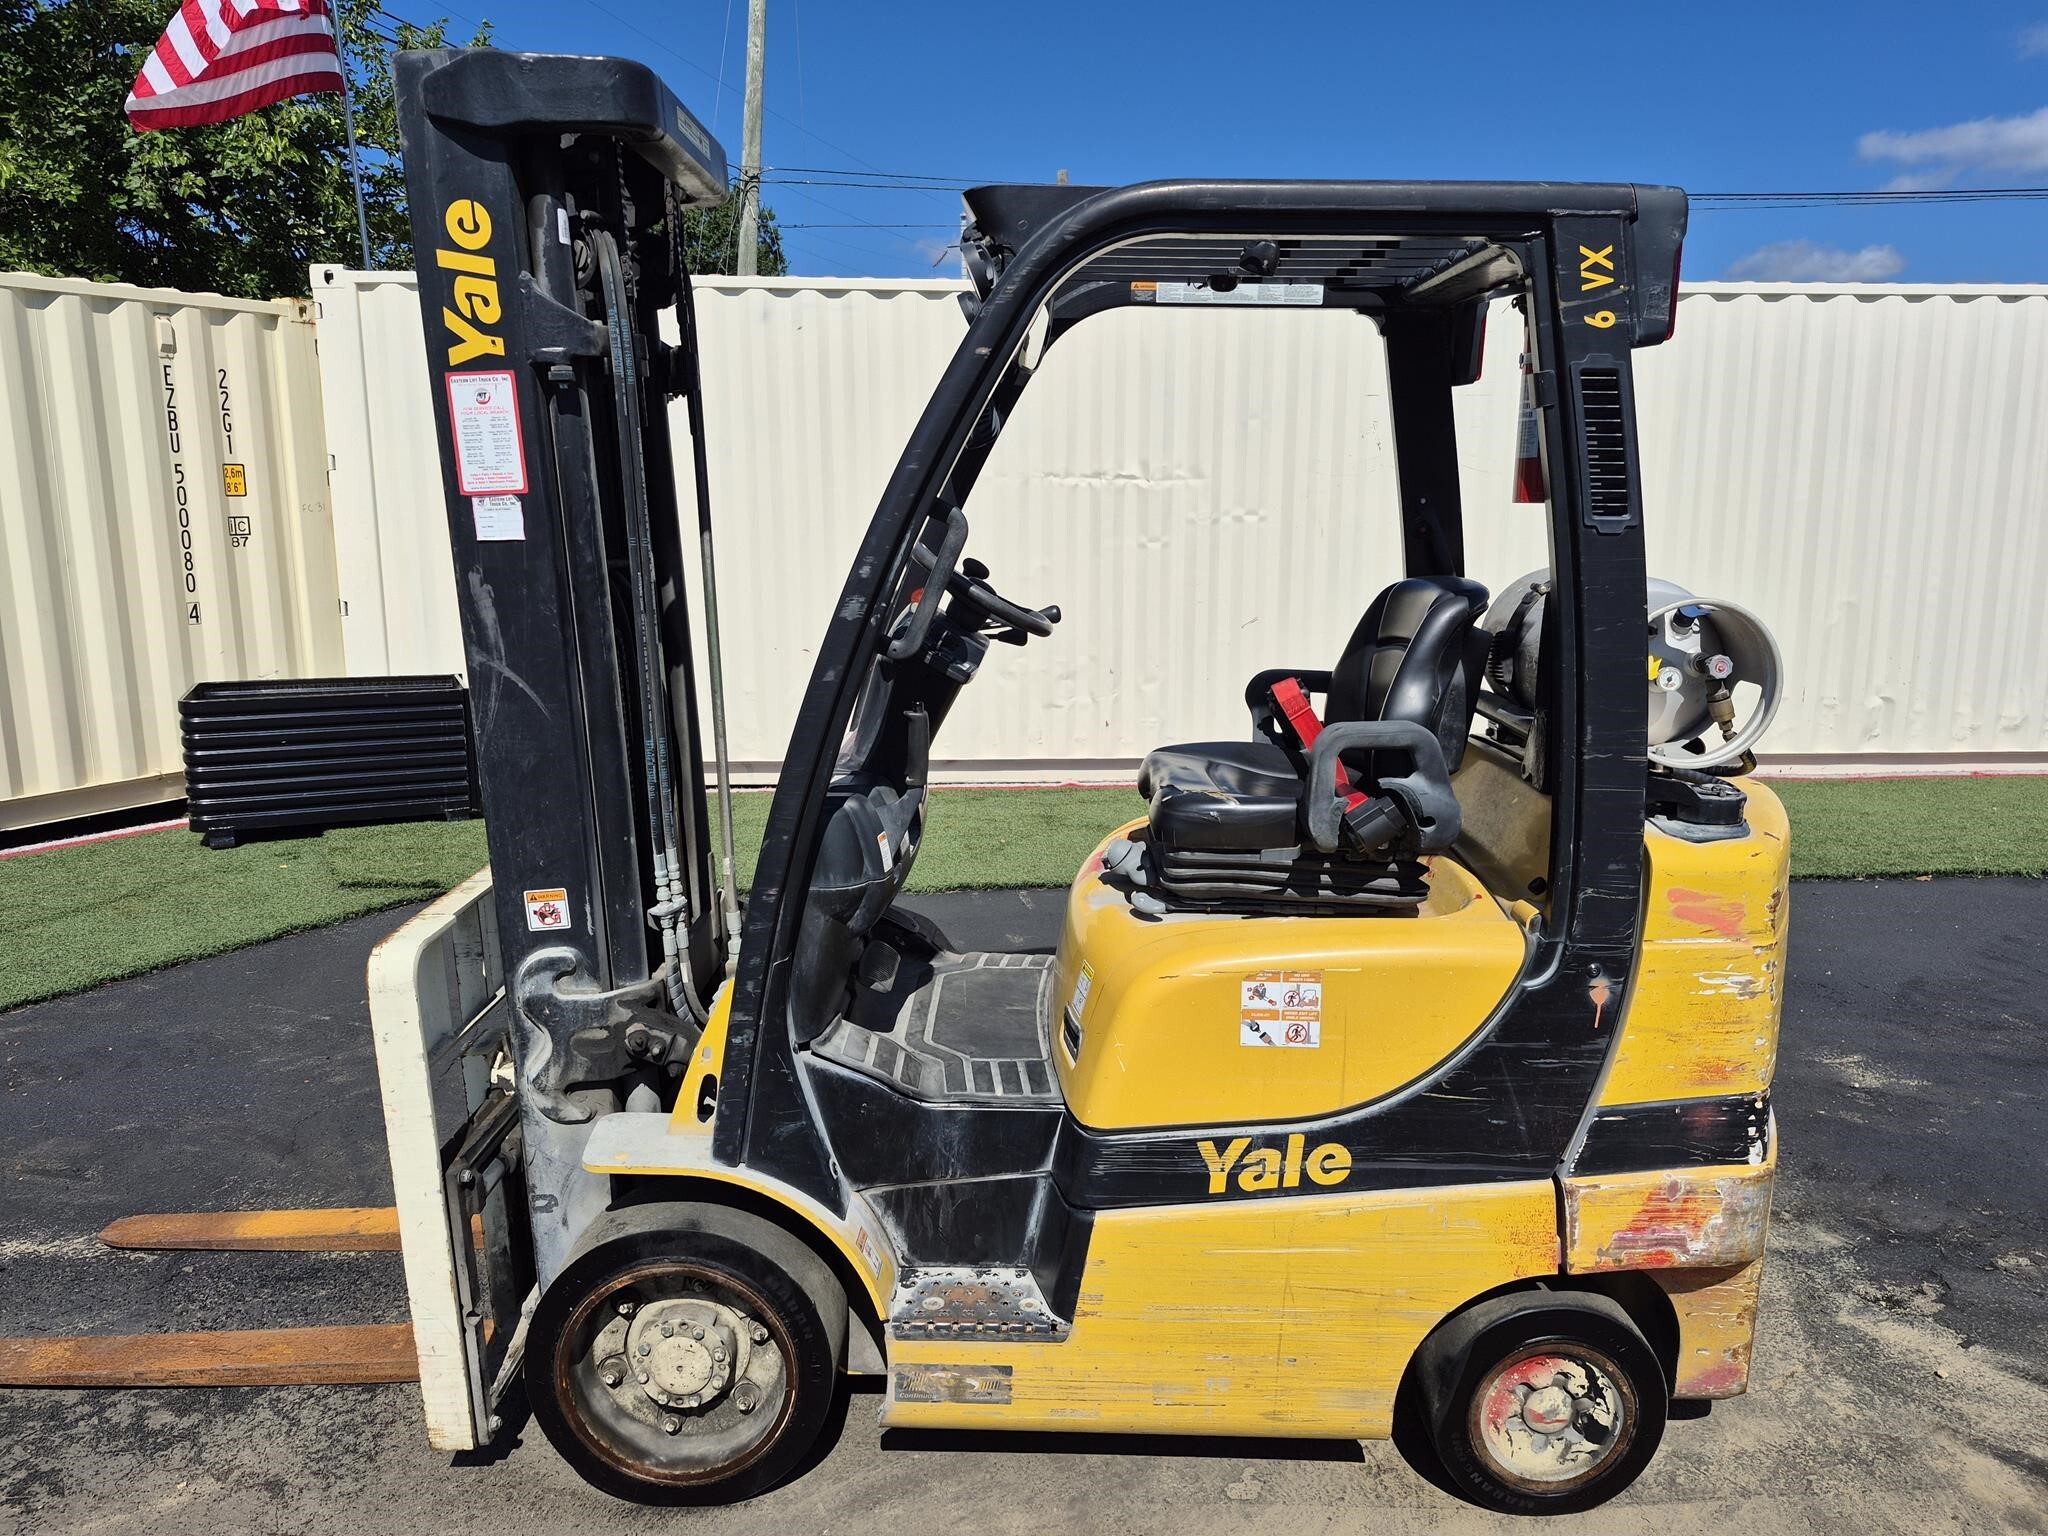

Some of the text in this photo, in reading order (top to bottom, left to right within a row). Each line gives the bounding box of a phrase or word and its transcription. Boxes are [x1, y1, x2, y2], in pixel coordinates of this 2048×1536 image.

[435, 199, 506, 367] Yale
[1579, 244, 1615, 292] VX
[217, 368, 233, 455] 22G1
[163, 364, 200, 624] EZBU 500080 4
[231, 537, 249, 548] 87
[1196, 1132, 1353, 1194] Yale
